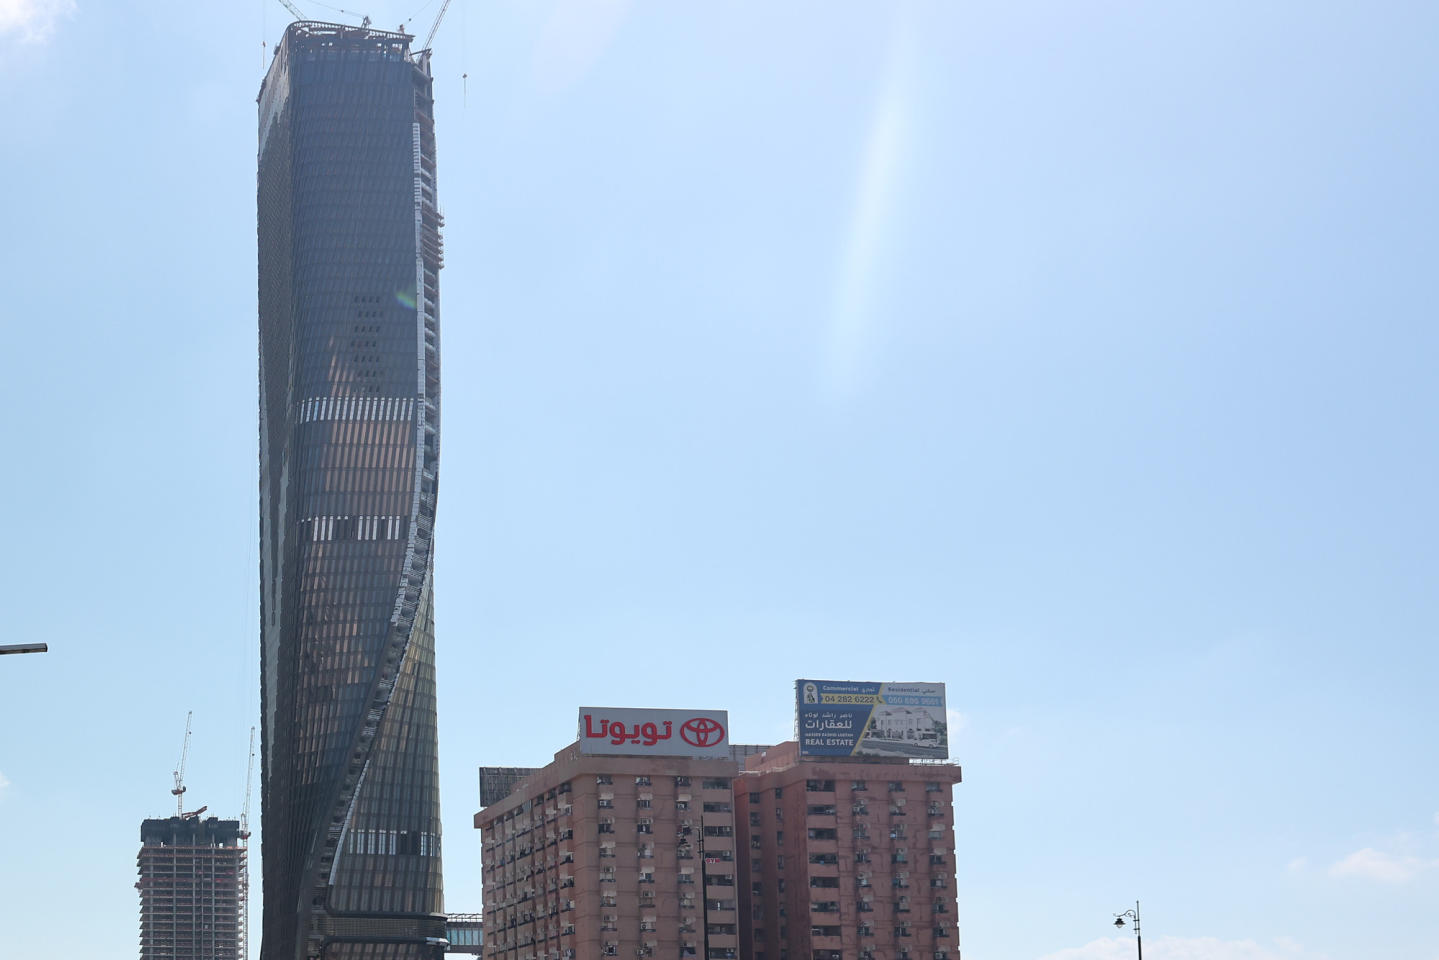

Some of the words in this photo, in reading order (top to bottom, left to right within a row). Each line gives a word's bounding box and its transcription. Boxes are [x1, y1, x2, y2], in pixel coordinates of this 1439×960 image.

[584, 714, 673, 747] تويوتا
[805, 719, 853, 731] للعقارات
[805, 738, 824, 746] REAL
[826, 738, 854, 746] ESTATE
